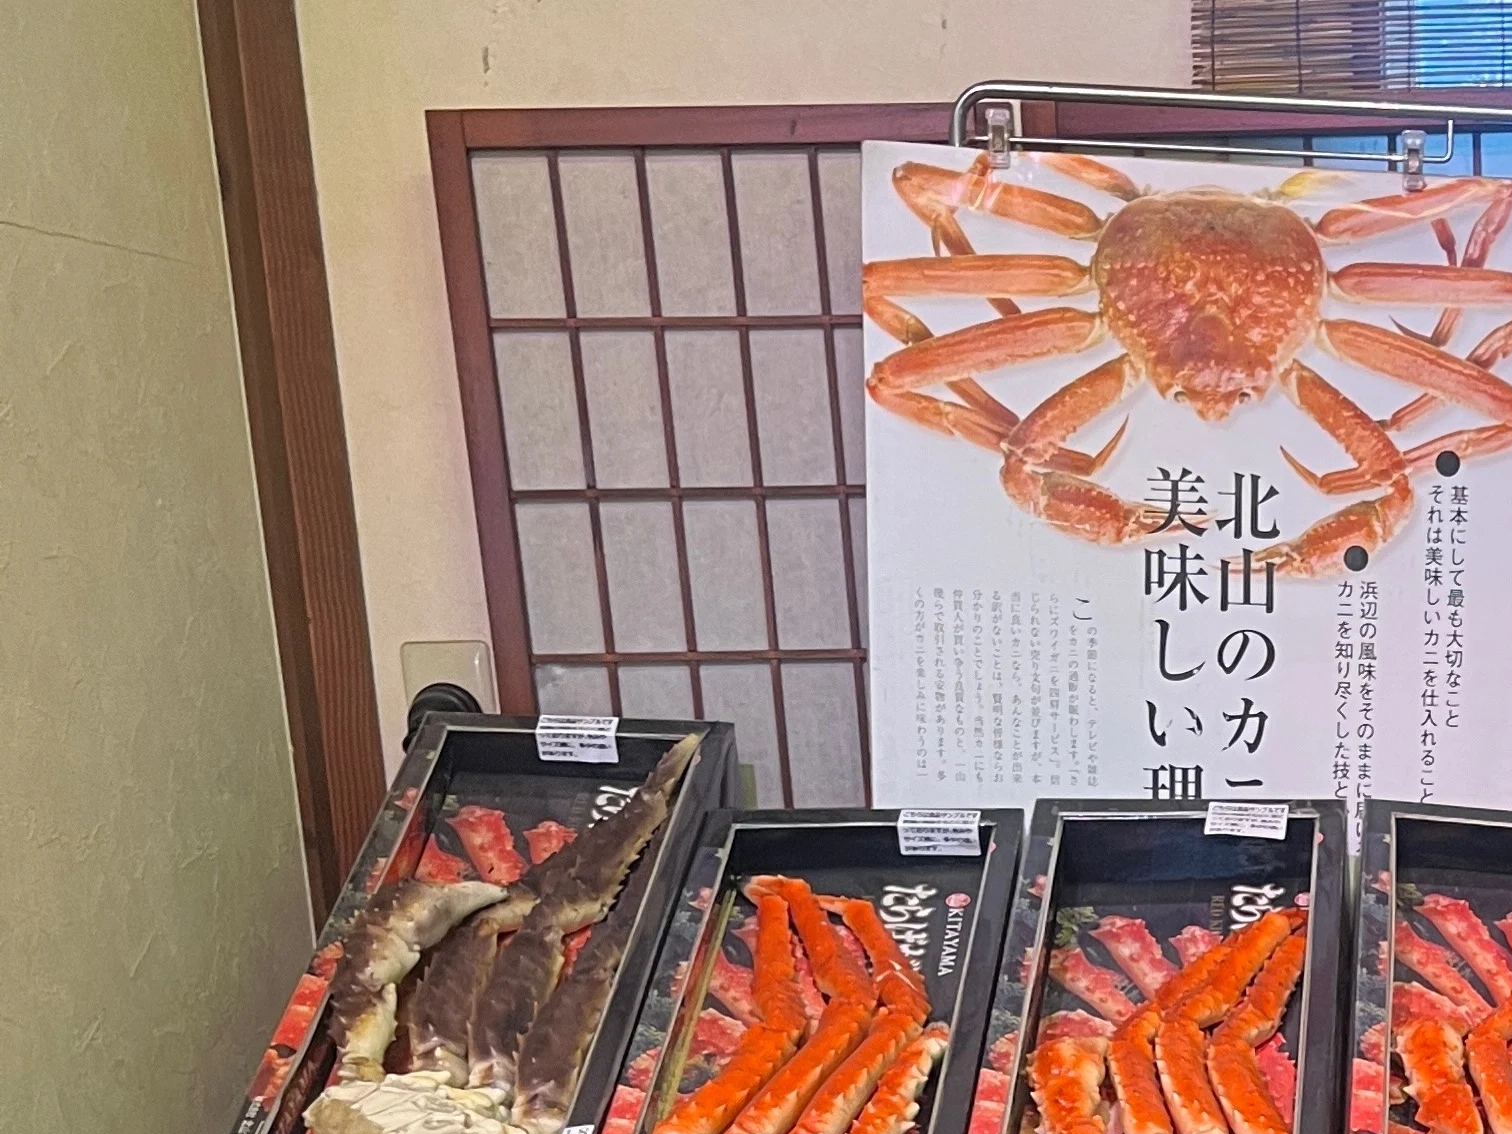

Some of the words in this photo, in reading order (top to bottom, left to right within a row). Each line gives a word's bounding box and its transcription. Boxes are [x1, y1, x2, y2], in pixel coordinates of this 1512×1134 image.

[1143, 467, 1209, 799] 美味しい理
[1420, 485, 1444, 803] それは美味しいカニを仕入れること
[1445, 486, 1469, 728] 基本にして最も大切なこと
[938, 908, 963, 976] KITAYAMA
